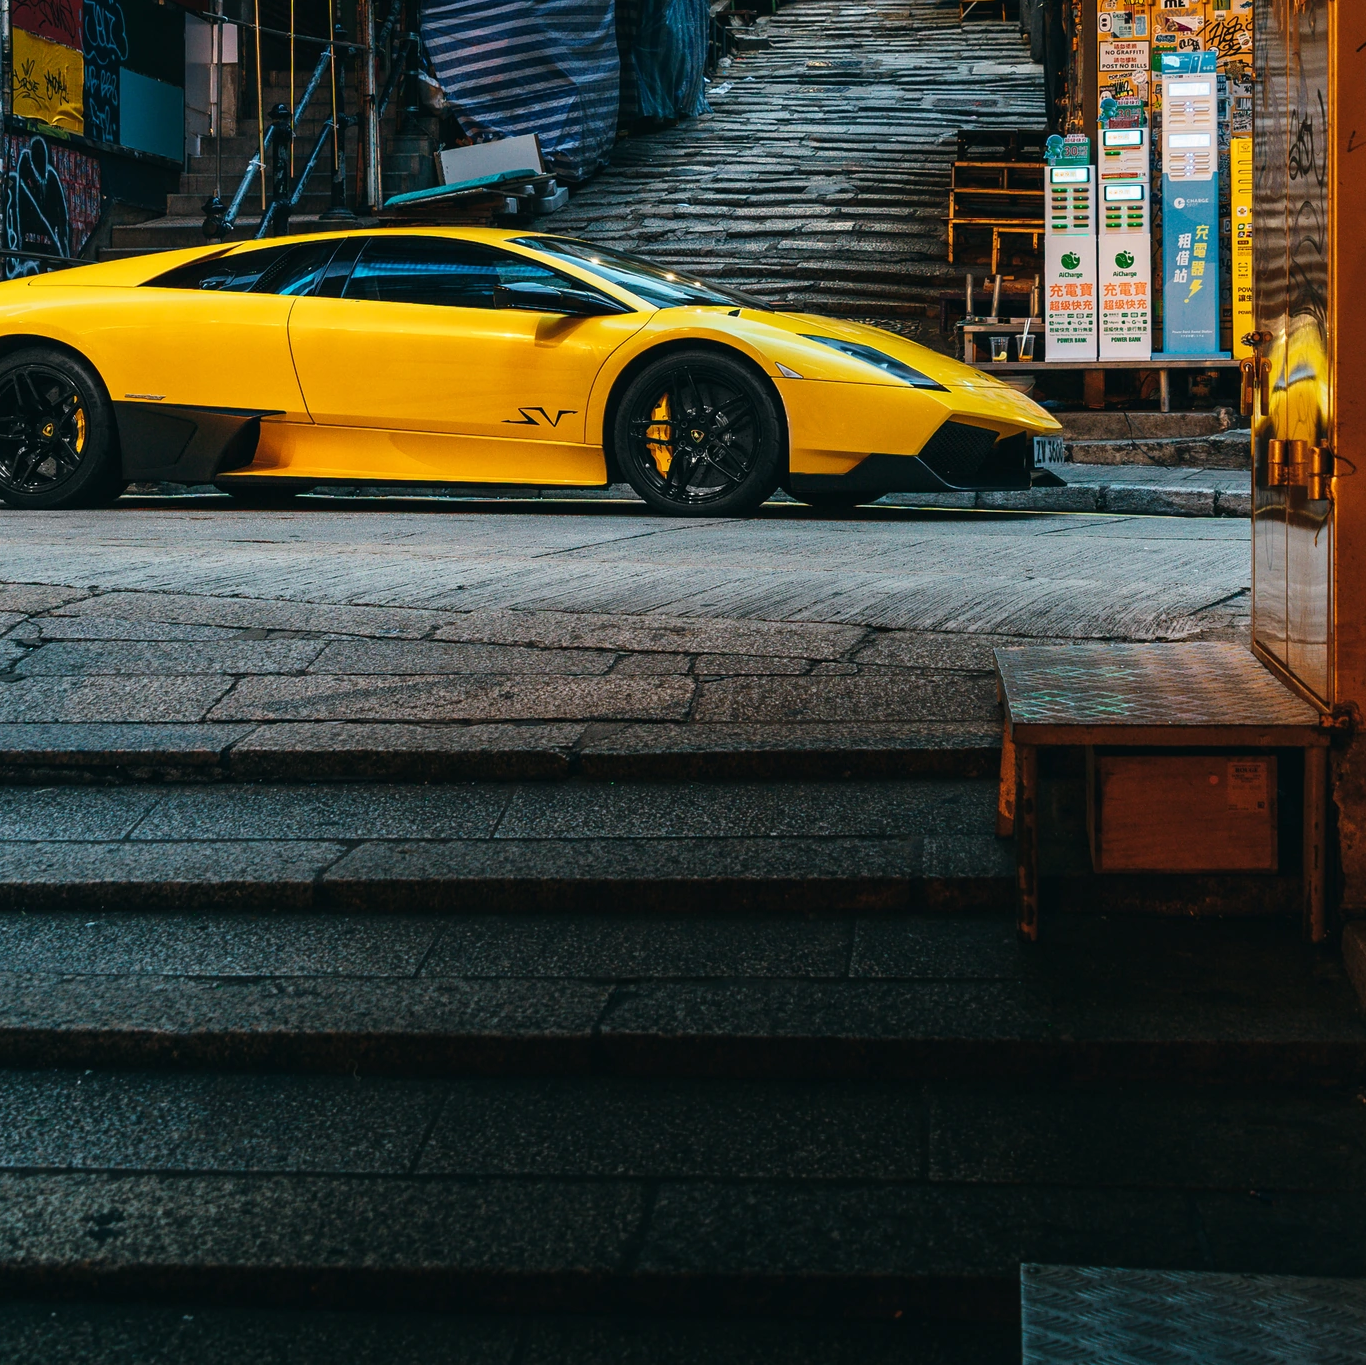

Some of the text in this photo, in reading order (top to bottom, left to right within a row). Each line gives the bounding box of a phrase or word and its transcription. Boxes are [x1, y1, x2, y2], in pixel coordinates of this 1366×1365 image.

[1064, 145, 1078, 157] 30
[1173, 233, 1192, 283] 租借站
[1191, 225, 1209, 276] 充電器
[1049, 283, 1093, 298] 充電寶
[1103, 282, 1147, 297] 充電寶
[501, 407, 578, 427] SV
